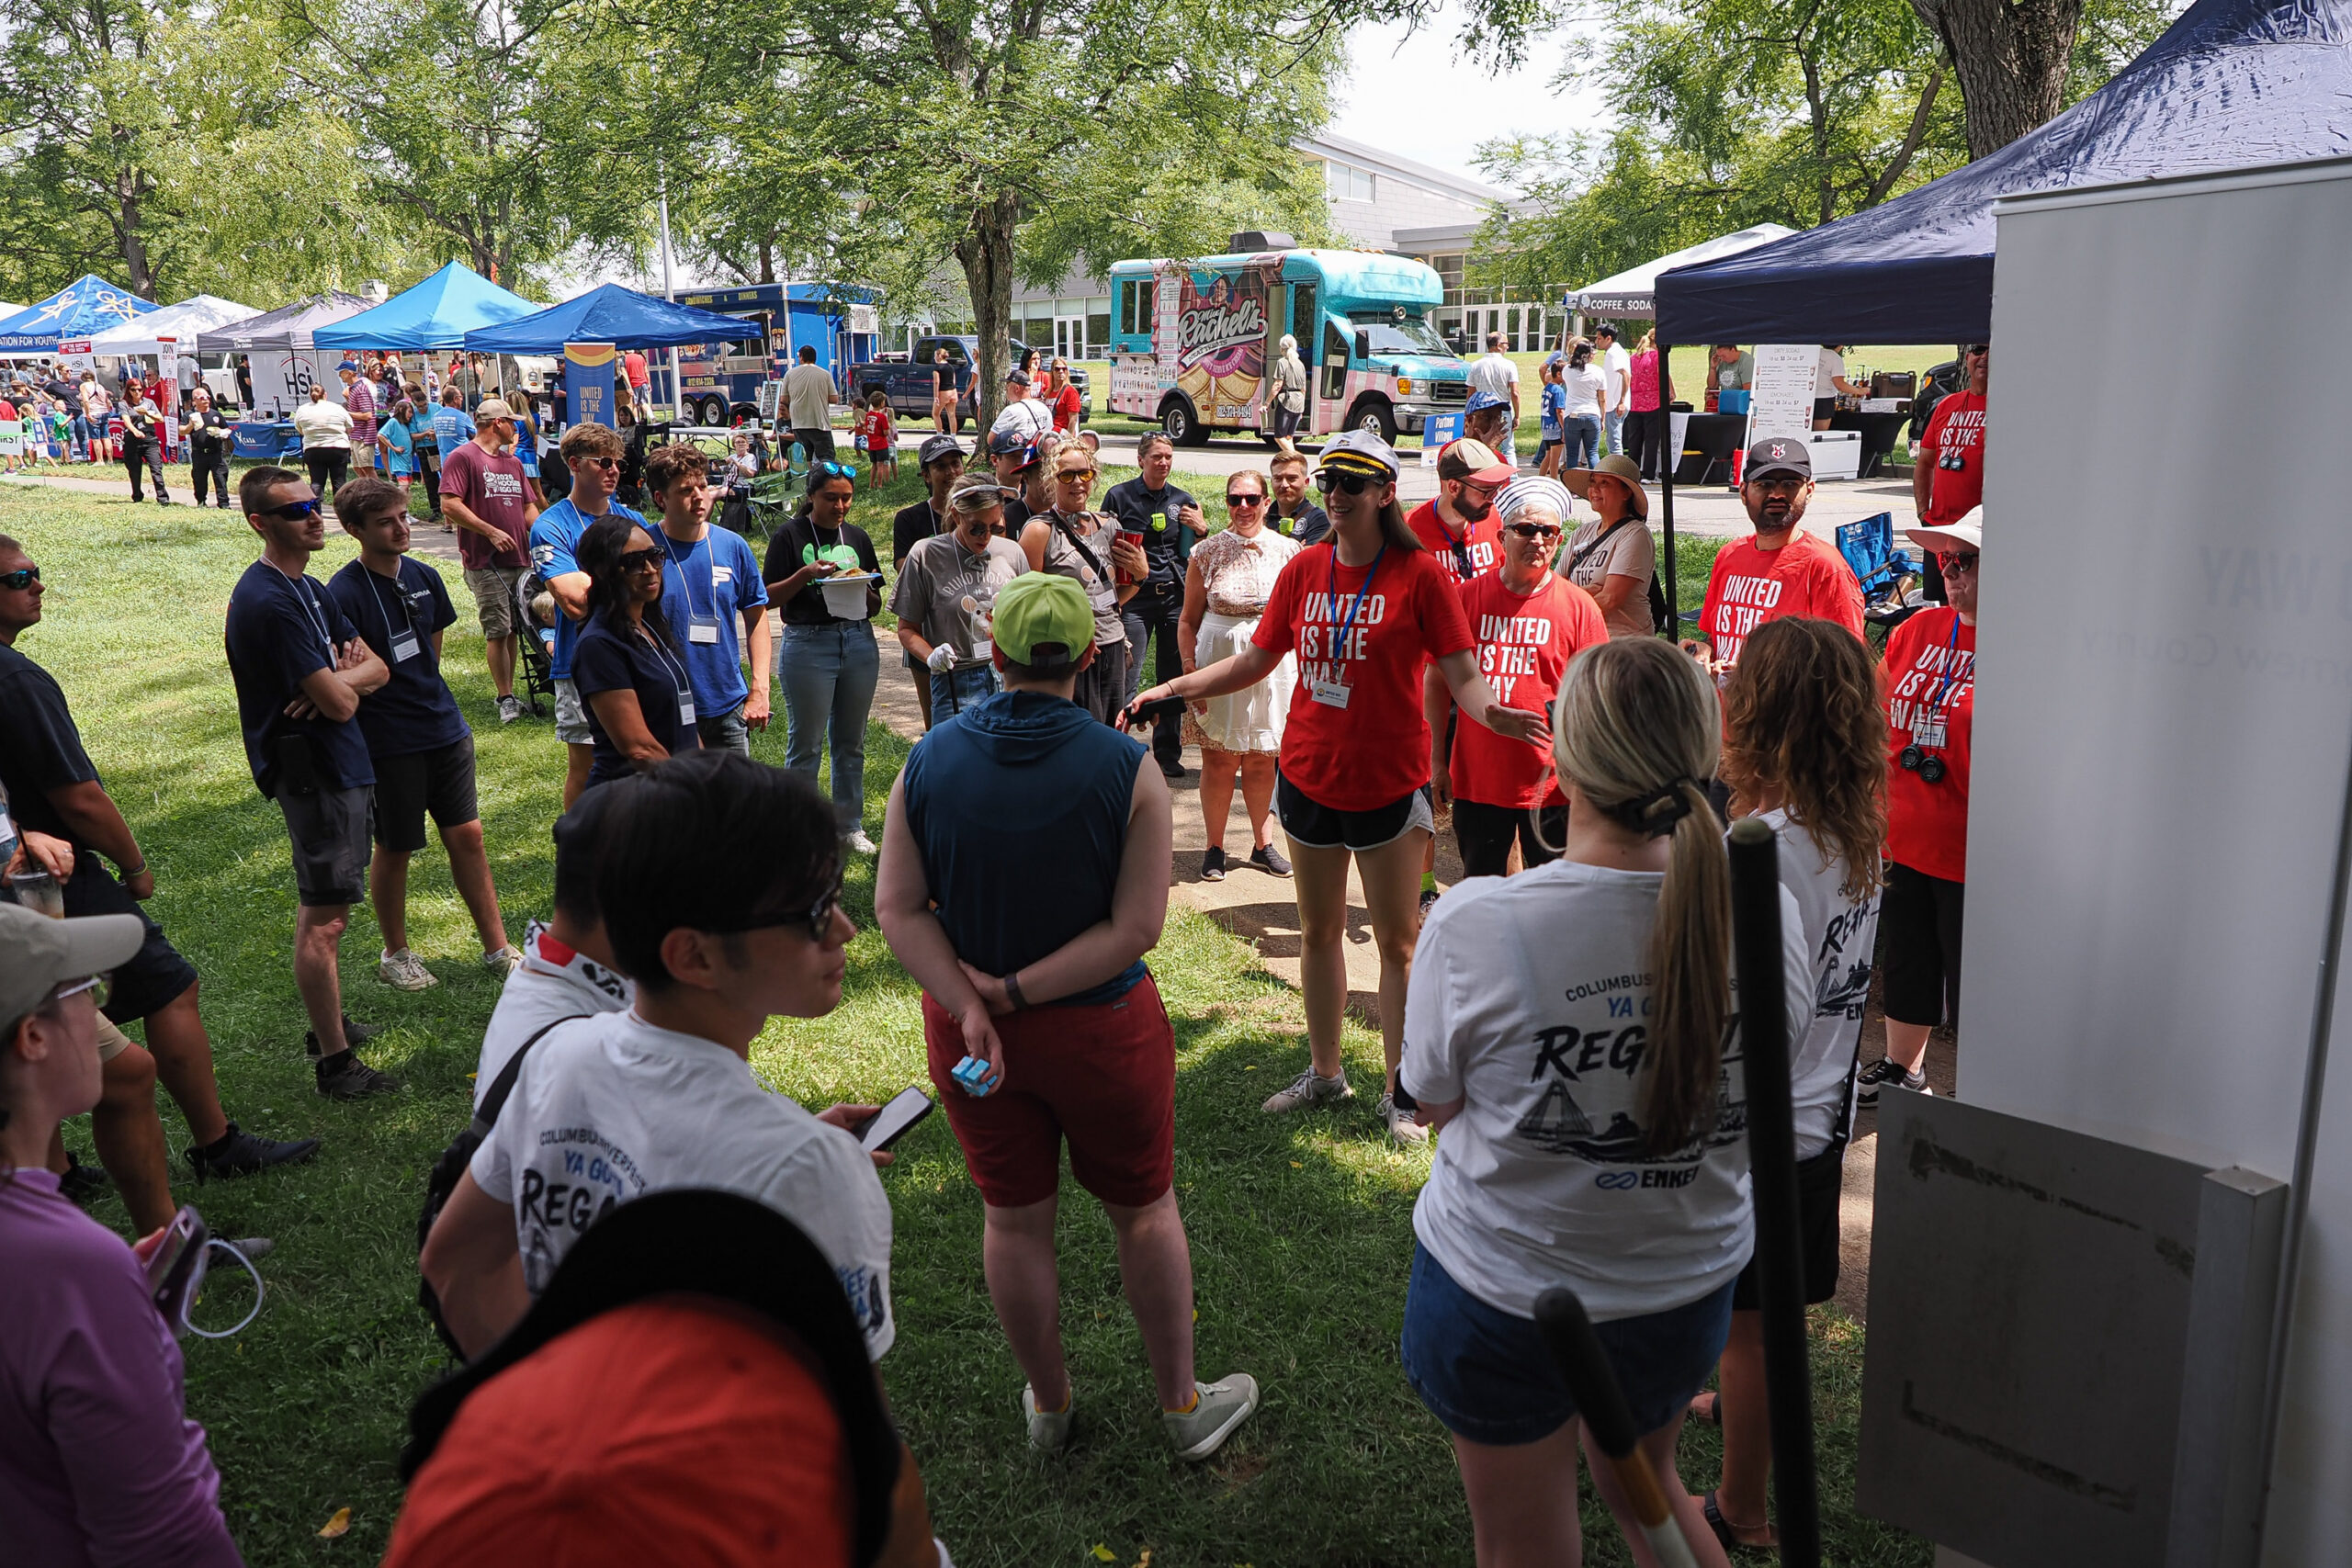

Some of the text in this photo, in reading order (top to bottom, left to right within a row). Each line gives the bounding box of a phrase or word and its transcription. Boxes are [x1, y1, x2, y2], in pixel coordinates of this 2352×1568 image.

[739, 291, 758, 301] DINNERS
[1590, 299, 1652, 312] COFFEE, SODA
[1179, 300, 1261, 351] Rachel's
[19, 337, 34, 347] FOR
[35, 336, 58, 346] YOUTH
[580, 387, 603, 400] UNITED
[581, 400, 600, 412] IS THE
[581, 412, 595, 423] WAY
[1436, 416, 1455, 429] Partner
[1435, 431, 1453, 444] Village
[1940, 428, 1980, 446] IS THE
[942, 572, 973, 596] BLIND
[1577, 570, 1594, 587] THE
[1723, 574, 1782, 609] UNITED
[1304, 592, 1385, 625] UNITED
[1715, 604, 1764, 636] IS THE
[1479, 614, 1552, 646] UNITED
[1301, 626, 1369, 660] IS THE
[1476, 643, 1538, 675] IS THE
[1300, 660, 1347, 691] WAY
[1485, 674, 1517, 704] AY
[1894, 670, 1974, 707] IS THE
[1565, 974, 1654, 1003] COLUMBUS
[1608, 996, 1634, 1019] YA
[564, 1150, 585, 1177] YA
